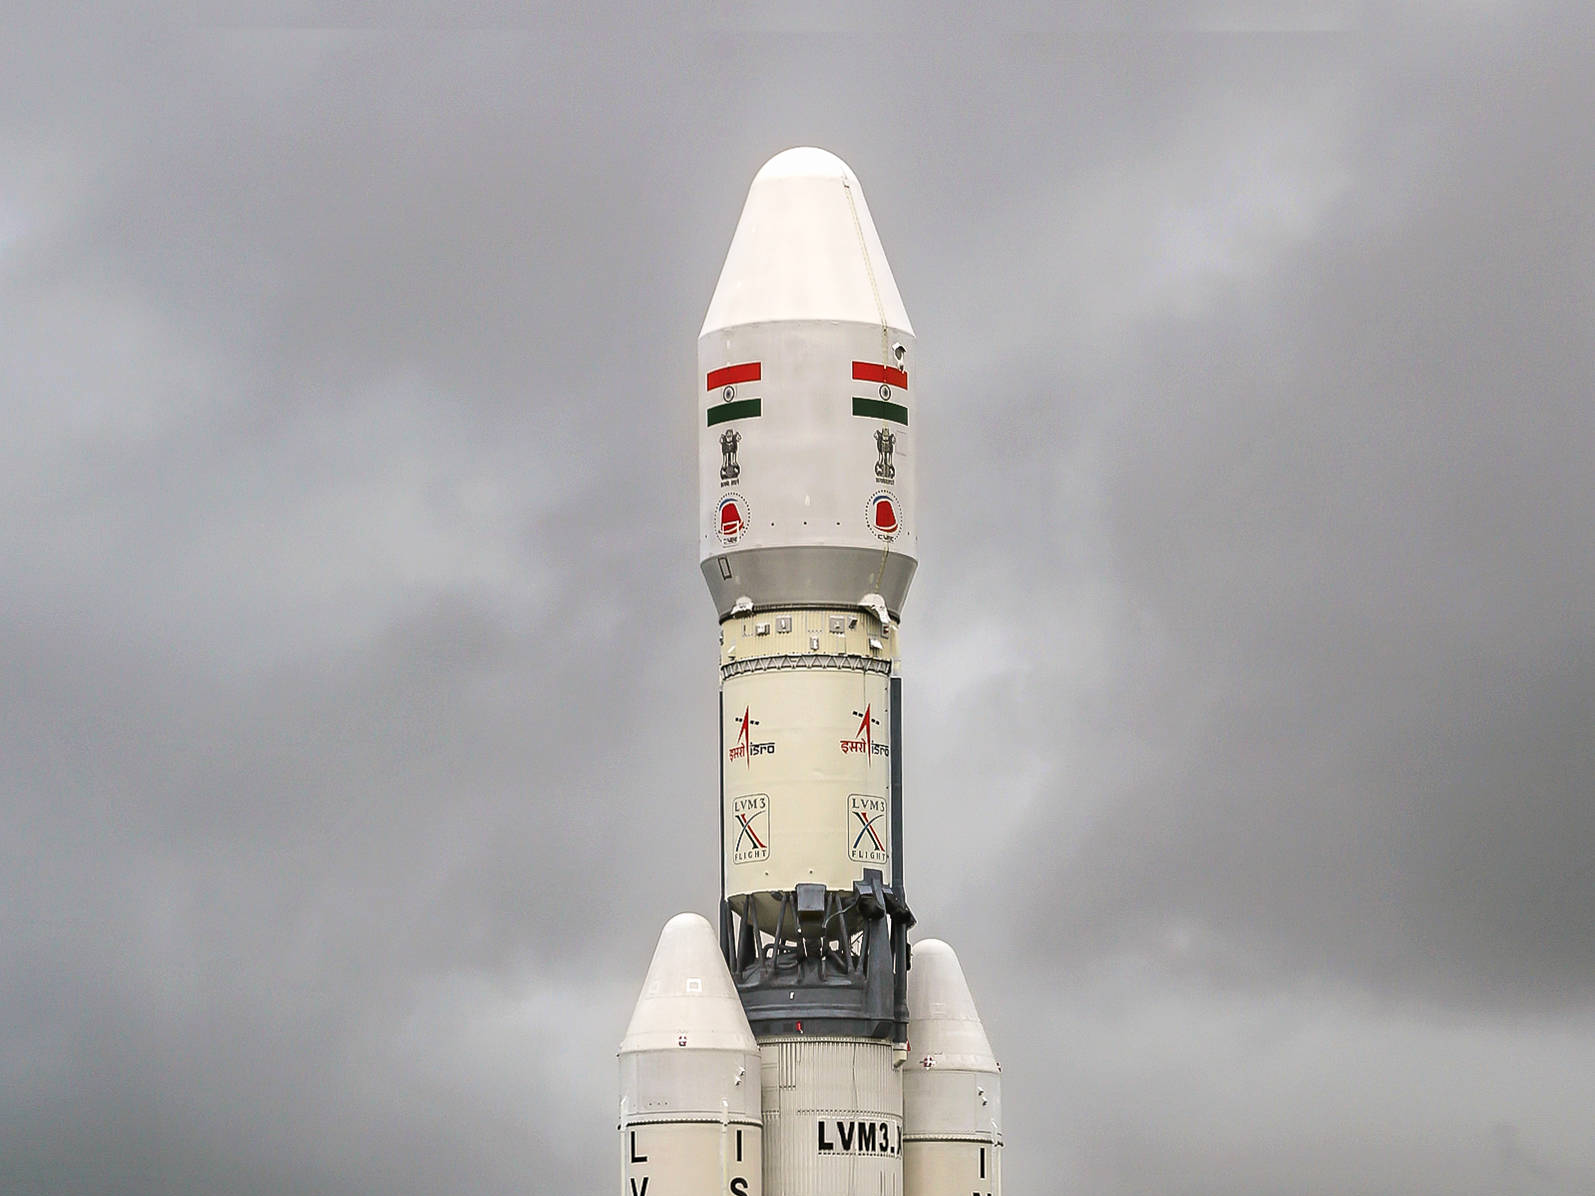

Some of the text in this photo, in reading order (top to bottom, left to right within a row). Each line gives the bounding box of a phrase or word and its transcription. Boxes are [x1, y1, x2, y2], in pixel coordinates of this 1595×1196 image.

[750, 742, 775, 756] isro
[840, 738, 866, 754] इसरो
[734, 798, 767, 812] LVM3
[852, 798, 885, 812] LVM3
[734, 850, 767, 861] FLIGHT
[852, 850, 886, 861] FLIGHT
